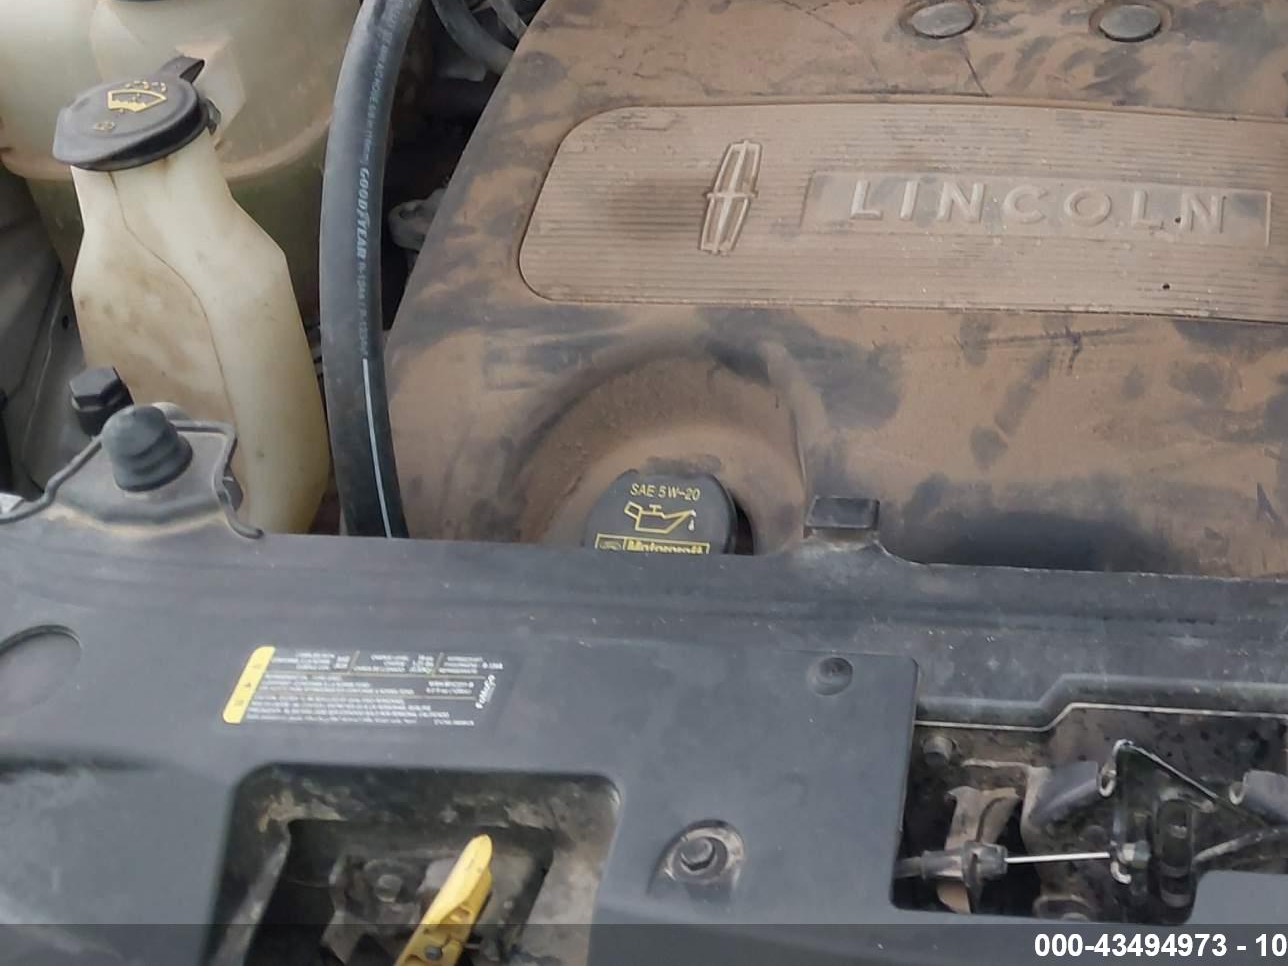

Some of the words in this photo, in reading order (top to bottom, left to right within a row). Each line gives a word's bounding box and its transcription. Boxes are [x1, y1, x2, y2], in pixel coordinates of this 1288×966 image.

[356, 167, 370, 259] GOODYEAR
[849, 179, 1228, 233] LINCOLN
[629, 483, 656, 498] SAE
[657, 484, 701, 502] 5W-20
